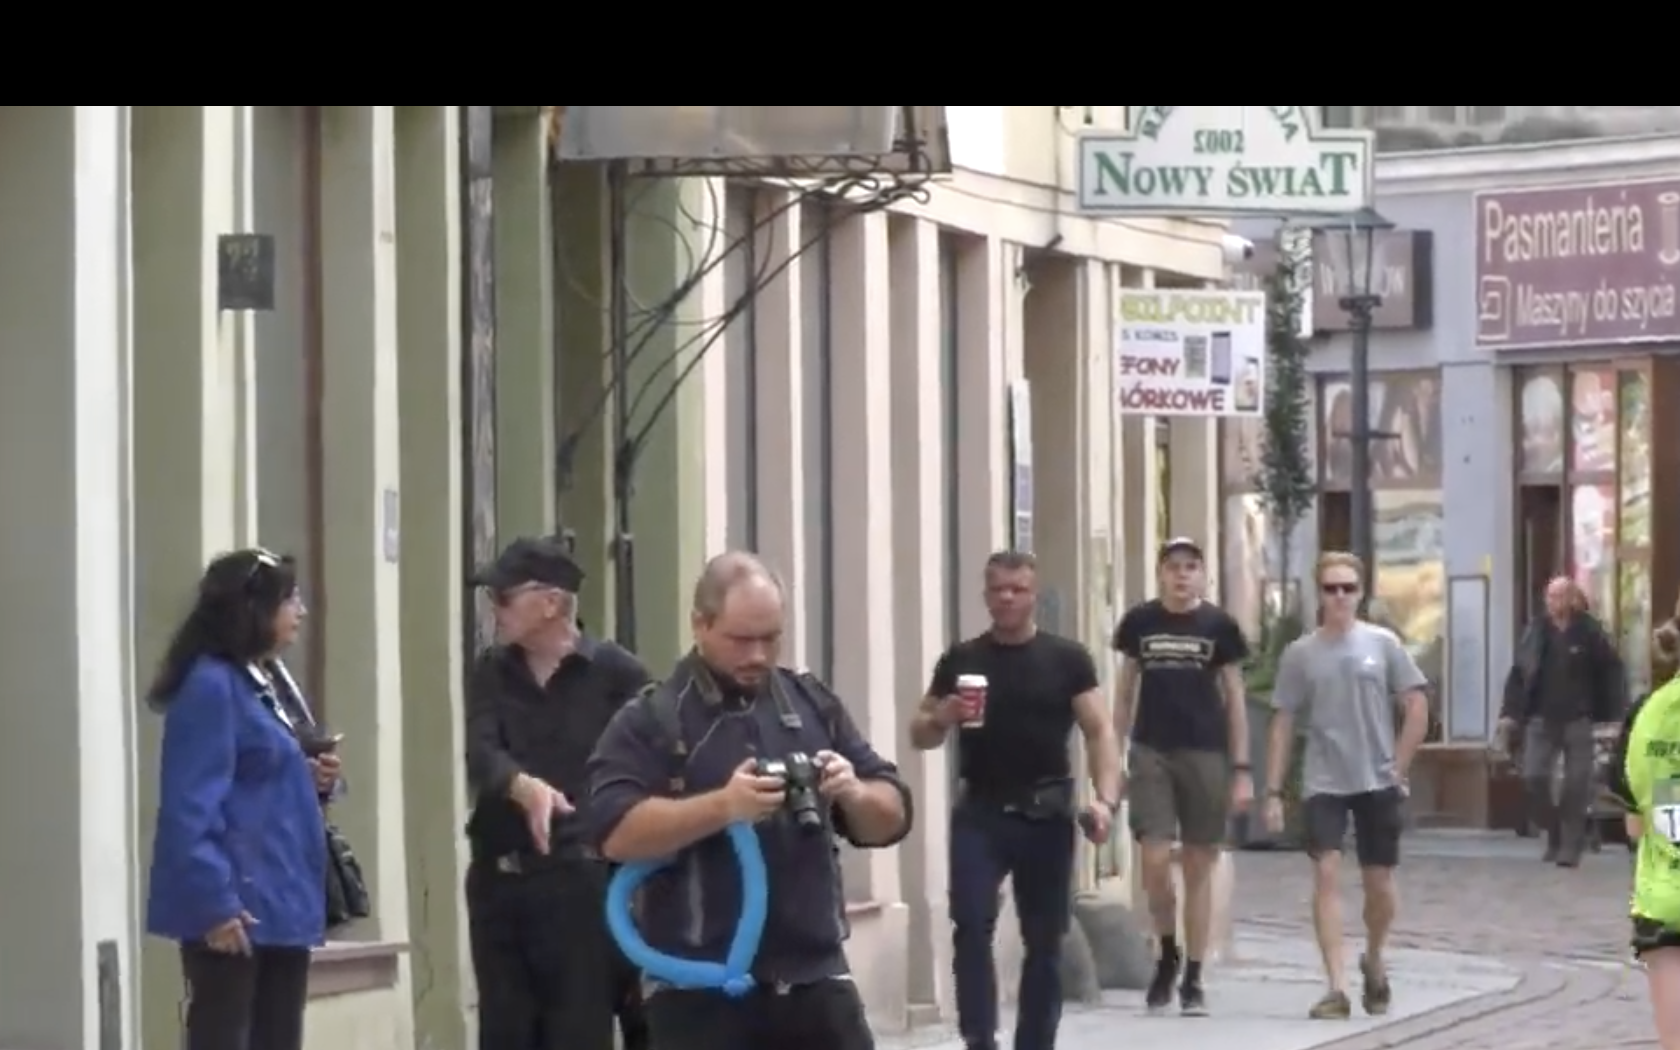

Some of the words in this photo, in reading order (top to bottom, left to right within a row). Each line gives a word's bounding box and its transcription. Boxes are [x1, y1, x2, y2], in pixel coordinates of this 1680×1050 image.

[1093, 151, 1214, 197] NOWY
[1226, 152, 1357, 198] ŚWIAT
[1484, 189, 1643, 263] Pasmanteria
[1516, 283, 1589, 335] Maszyny
[1594, 277, 1617, 320] do
[1621, 275, 1675, 329] szycia
